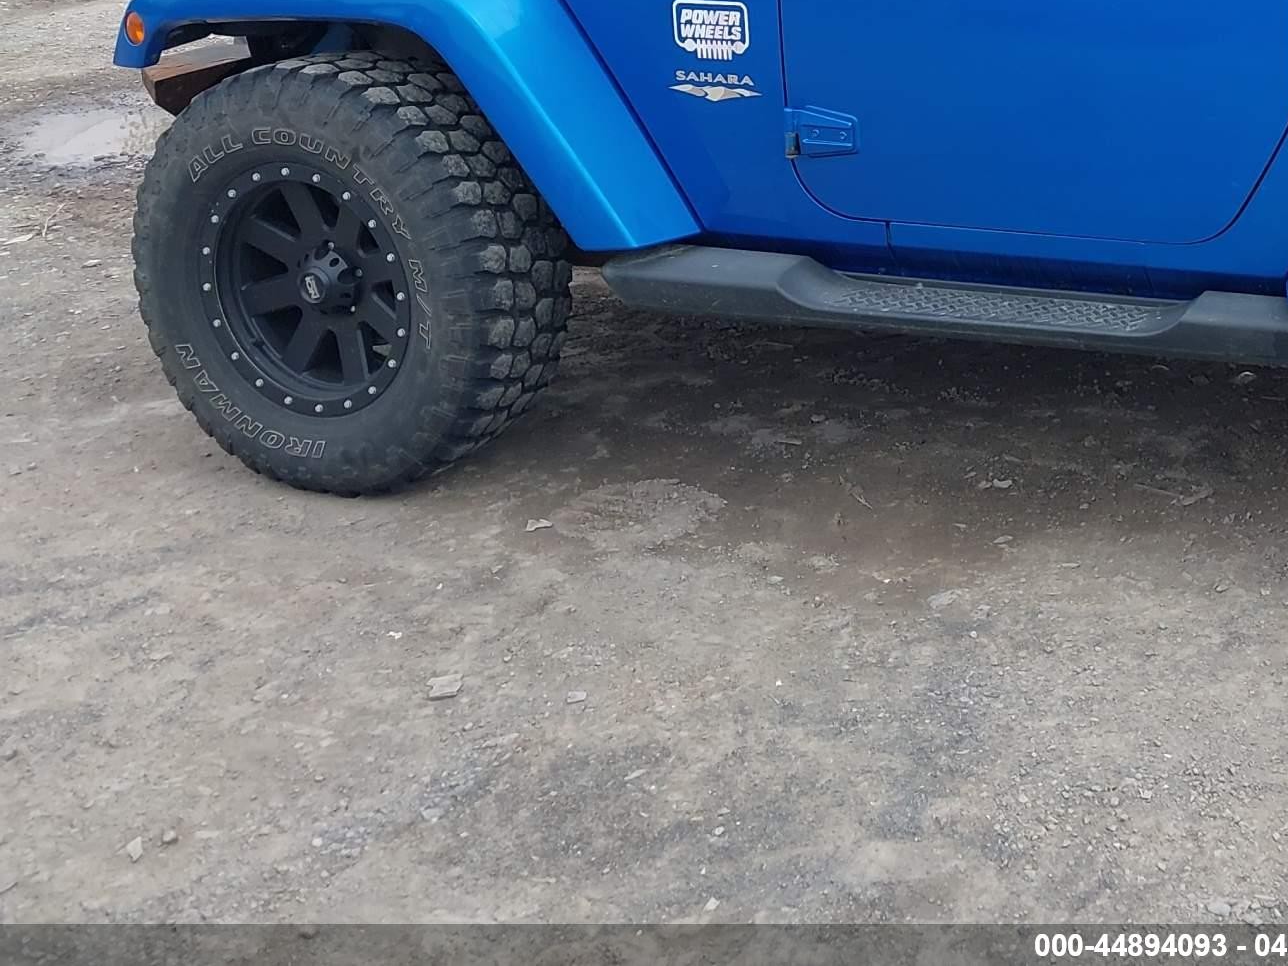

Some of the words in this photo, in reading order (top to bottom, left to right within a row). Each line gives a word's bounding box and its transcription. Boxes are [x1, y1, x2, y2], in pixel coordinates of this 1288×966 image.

[680, 8, 741, 26] POWER
[680, 24, 742, 41] WHEELS
[675, 70, 754, 86] SAHARA
[188, 133, 243, 183] ALL
[251, 126, 412, 240] COUNTRY
[408, 258, 433, 350] M/T
[175, 343, 327, 460] IRONMAN
